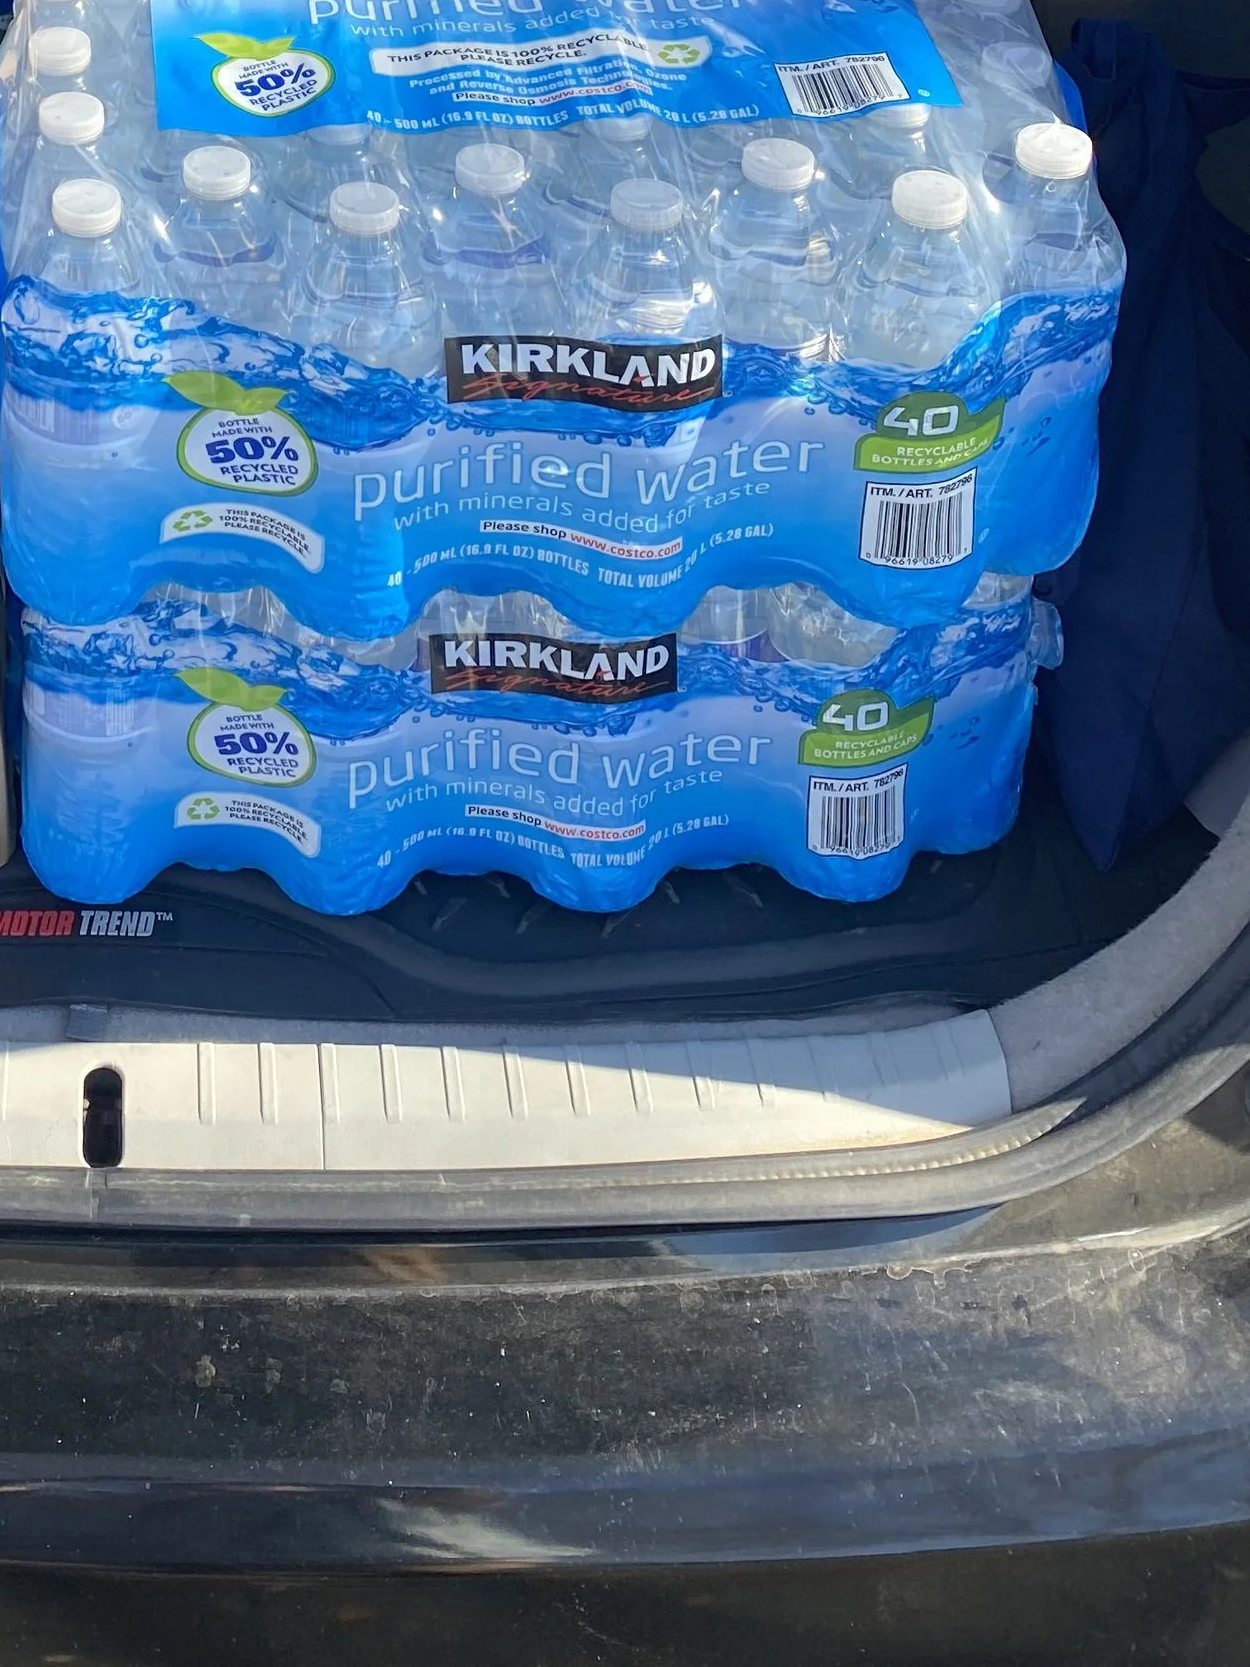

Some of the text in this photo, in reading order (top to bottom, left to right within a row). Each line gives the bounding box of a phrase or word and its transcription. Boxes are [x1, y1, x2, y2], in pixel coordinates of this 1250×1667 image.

[350, 5, 714, 37] with minerals added taste
[387, 45, 554, 63] THIS PACKAGE IS 100%
[461, 49, 587, 66] PLEASE RECYCLE.
[238, 62, 289, 80] MADE WITH
[243, 60, 276, 72] BOTTLE
[234, 63, 316, 96] 50%
[409, 70, 481, 88] Processed
[505, 67, 573, 85] Advanced
[645, 68, 687, 81] Ozone
[430, 82, 455, 95] and
[459, 80, 514, 94] Reverse
[250, 80, 317, 105] RECYCLED
[262, 87, 317, 111] PLASTIC
[455, 92, 500, 102] Please
[503, 93, 536, 106] shop
[367, 110, 382, 123] 40
[394, 119, 419, 130] 500
[421, 118, 440, 129] ML
[441, 111, 473, 124] (16.9
[475, 111, 490, 122] FL
[517, 110, 568, 126] BOTTLES
[576, 103, 612, 115] TOTAL
[616, 99, 663, 116] VOLUME
[664, 110, 680, 121] 20
[729, 104, 760, 119] GAL)
[461, 343, 716, 386] KIRKLAND
[218, 418, 259, 428] BOTTLE
[884, 405, 959, 436] 40
[212, 426, 272, 438] MADE WITH
[205, 436, 299, 463] 50%
[897, 437, 975, 456] RECYCLABLE
[220, 463, 298, 475] RECYCLED
[872, 454, 962, 466] BOTTLES AND
[233, 474, 296, 485] PLASTIC
[354, 439, 824, 522] purified water
[939, 473, 973, 496] 782796
[393, 482, 770, 533] with minerals added for taste
[219, 515, 247, 523] 100%
[224, 522, 260, 531] PLEASE
[251, 512, 296, 534] PACKAGE
[297, 531, 306, 540] IS
[483, 521, 681, 558] Please shop www.costco.com
[387, 571, 402, 587] 40
[413, 551, 438, 574] 500
[440, 548, 457, 563] ML
[460, 543, 491, 557] (16.9
[495, 544, 509, 556] FL
[512, 545, 535, 560] OZ)
[537, 549, 590, 576] BOTTLES
[598, 567, 634, 588] TOTAL
[638, 565, 683, 589] VOLUME
[684, 550, 698, 575] 20
[709, 526, 742, 548] (5.28
[745, 523, 774, 538] GAL)
[444, 640, 670, 681] KIRKLAND
[220, 723, 248, 732] MADE
[226, 714, 263, 723] BOTTLE
[822, 702, 889, 731] 40
[214, 731, 299, 755] 50%
[814, 734, 918, 759] BOTTLES AND CAPS
[835, 730, 904, 749] RECYCLABLE
[227, 757, 299, 768] RECYCLED
[238, 766, 296, 778] PLASTIC
[349, 728, 772, 809] purified water
[874, 769, 904, 788] 782796
[386, 770, 723, 817] with minerals added for taste
[225, 806, 250, 814] 100%
[229, 813, 262, 821] PLEASE
[252, 803, 295, 822] PACKAGE
[296, 819, 304, 829] IS
[468, 806, 644, 840] Please shop www.costco.com
[377, 850, 391, 868] 40
[402, 830, 424, 851] 500
[427, 826, 443, 838] ML
[479, 828, 492, 839] FL
[495, 830, 515, 845] OZ)
[517, 834, 565, 859] BOTTLES
[570, 852, 602, 868] TOTAL
[606, 844, 646, 866] VOLUME
[703, 814, 730, 828] GAL)
